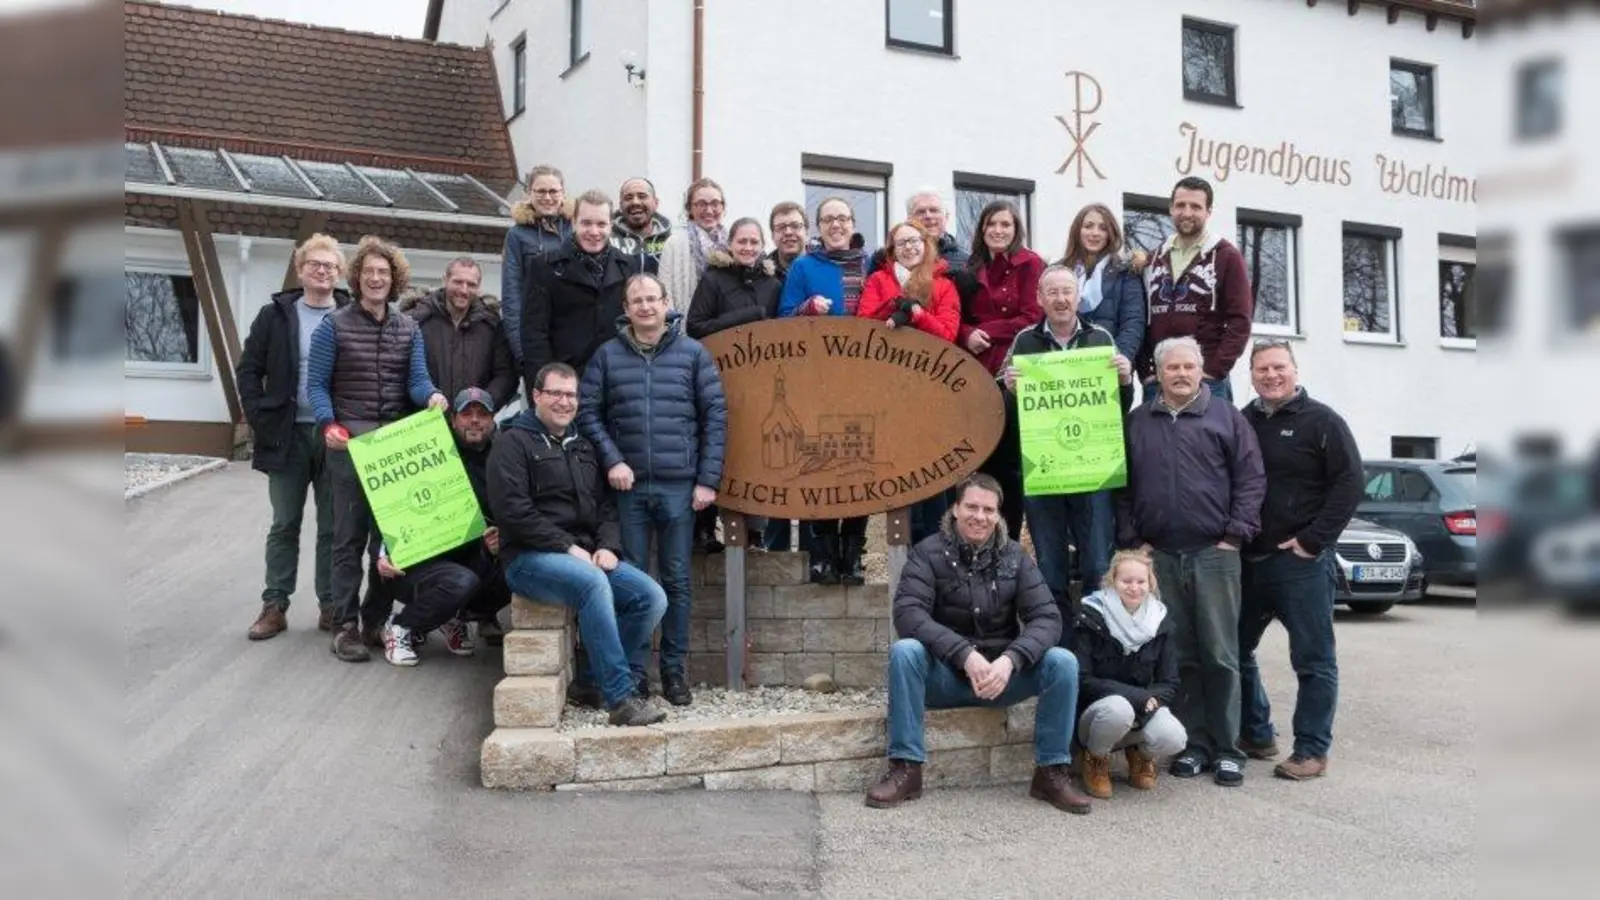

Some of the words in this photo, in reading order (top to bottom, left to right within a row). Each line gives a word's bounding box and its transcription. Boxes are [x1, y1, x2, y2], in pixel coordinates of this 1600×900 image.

[1175, 121, 1352, 188] Jugendhaus
[1174, 303, 1197, 312] YORK
[716, 332, 808, 372] ndhaus
[821, 328, 968, 393] Waldmühle
[1024, 383, 1037, 393] IN
[1040, 379, 1065, 392] DER
[1068, 376, 1104, 389] WELT
[1022, 389, 1108, 412] DAHOAM
[1063, 423, 1082, 438] 10
[364, 463, 378, 475] IN
[379, 451, 405, 469] DER
[404, 437, 439, 458] WELT
[366, 449, 448, 492] DAHOAM
[725, 479, 789, 506] LICH
[800, 438, 977, 506] WILLKOMMEN
[413, 487, 432, 504] 10
